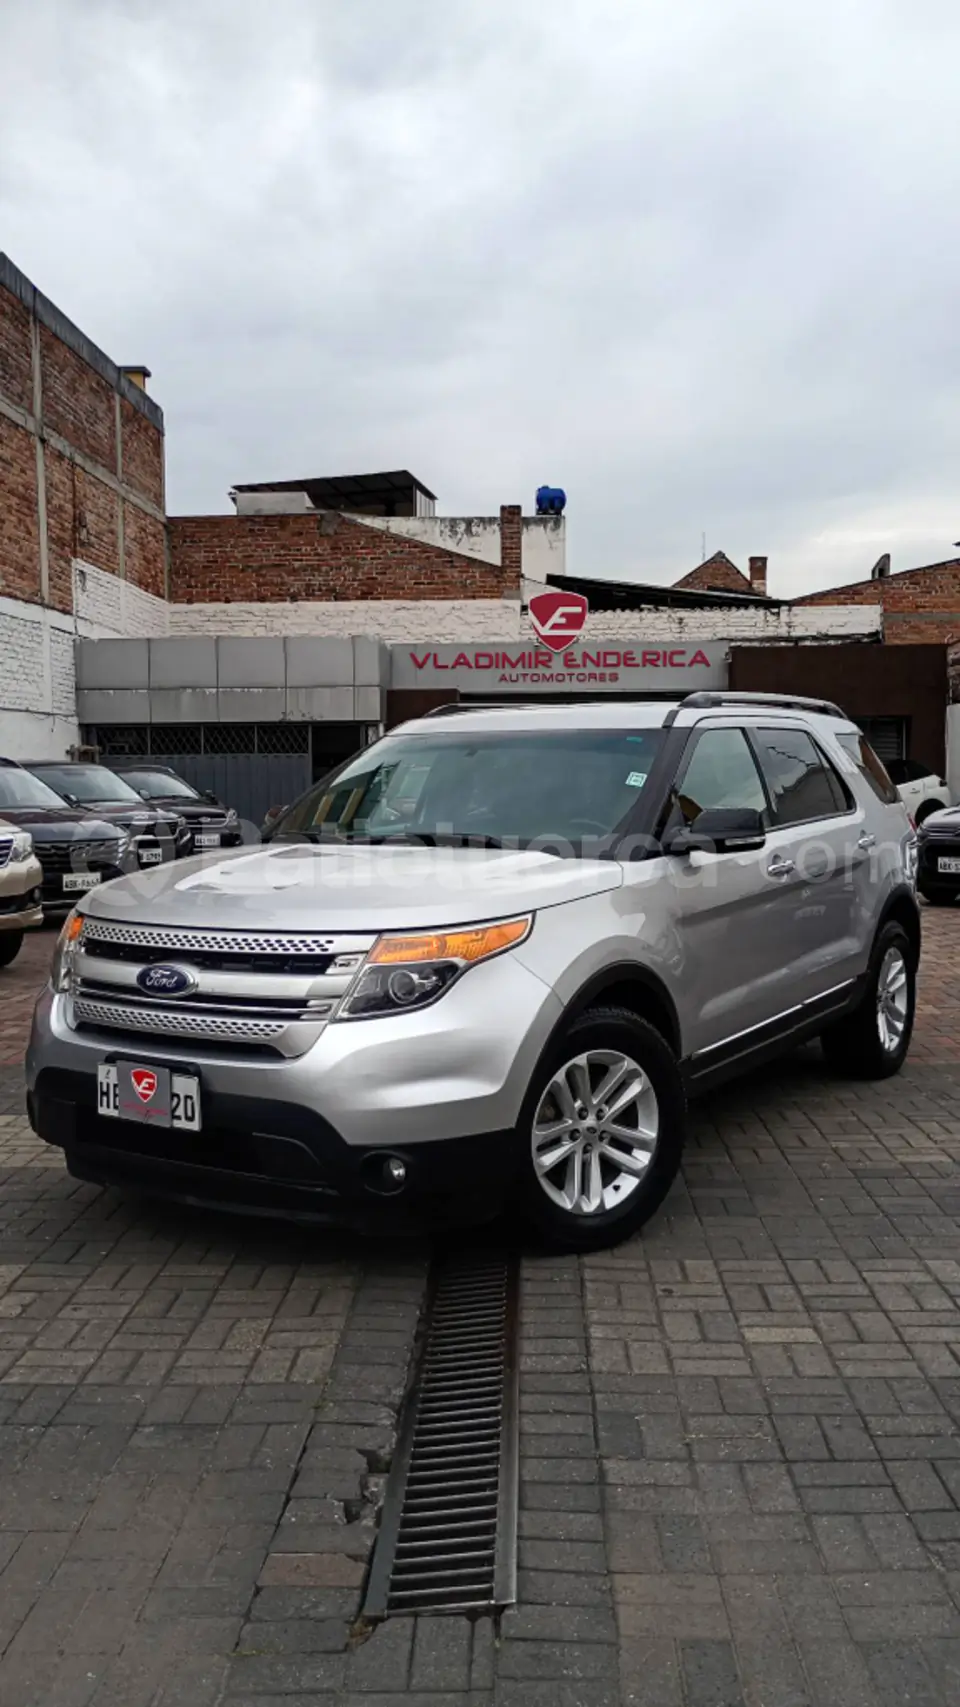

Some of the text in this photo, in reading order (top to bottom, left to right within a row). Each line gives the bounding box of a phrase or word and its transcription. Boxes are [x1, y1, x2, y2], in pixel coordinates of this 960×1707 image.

[409, 649, 711, 670] VLADIMIR ENDERICA
[498, 672, 619, 684] AUTOMOTORES
[146, 969, 178, 988] Ford
